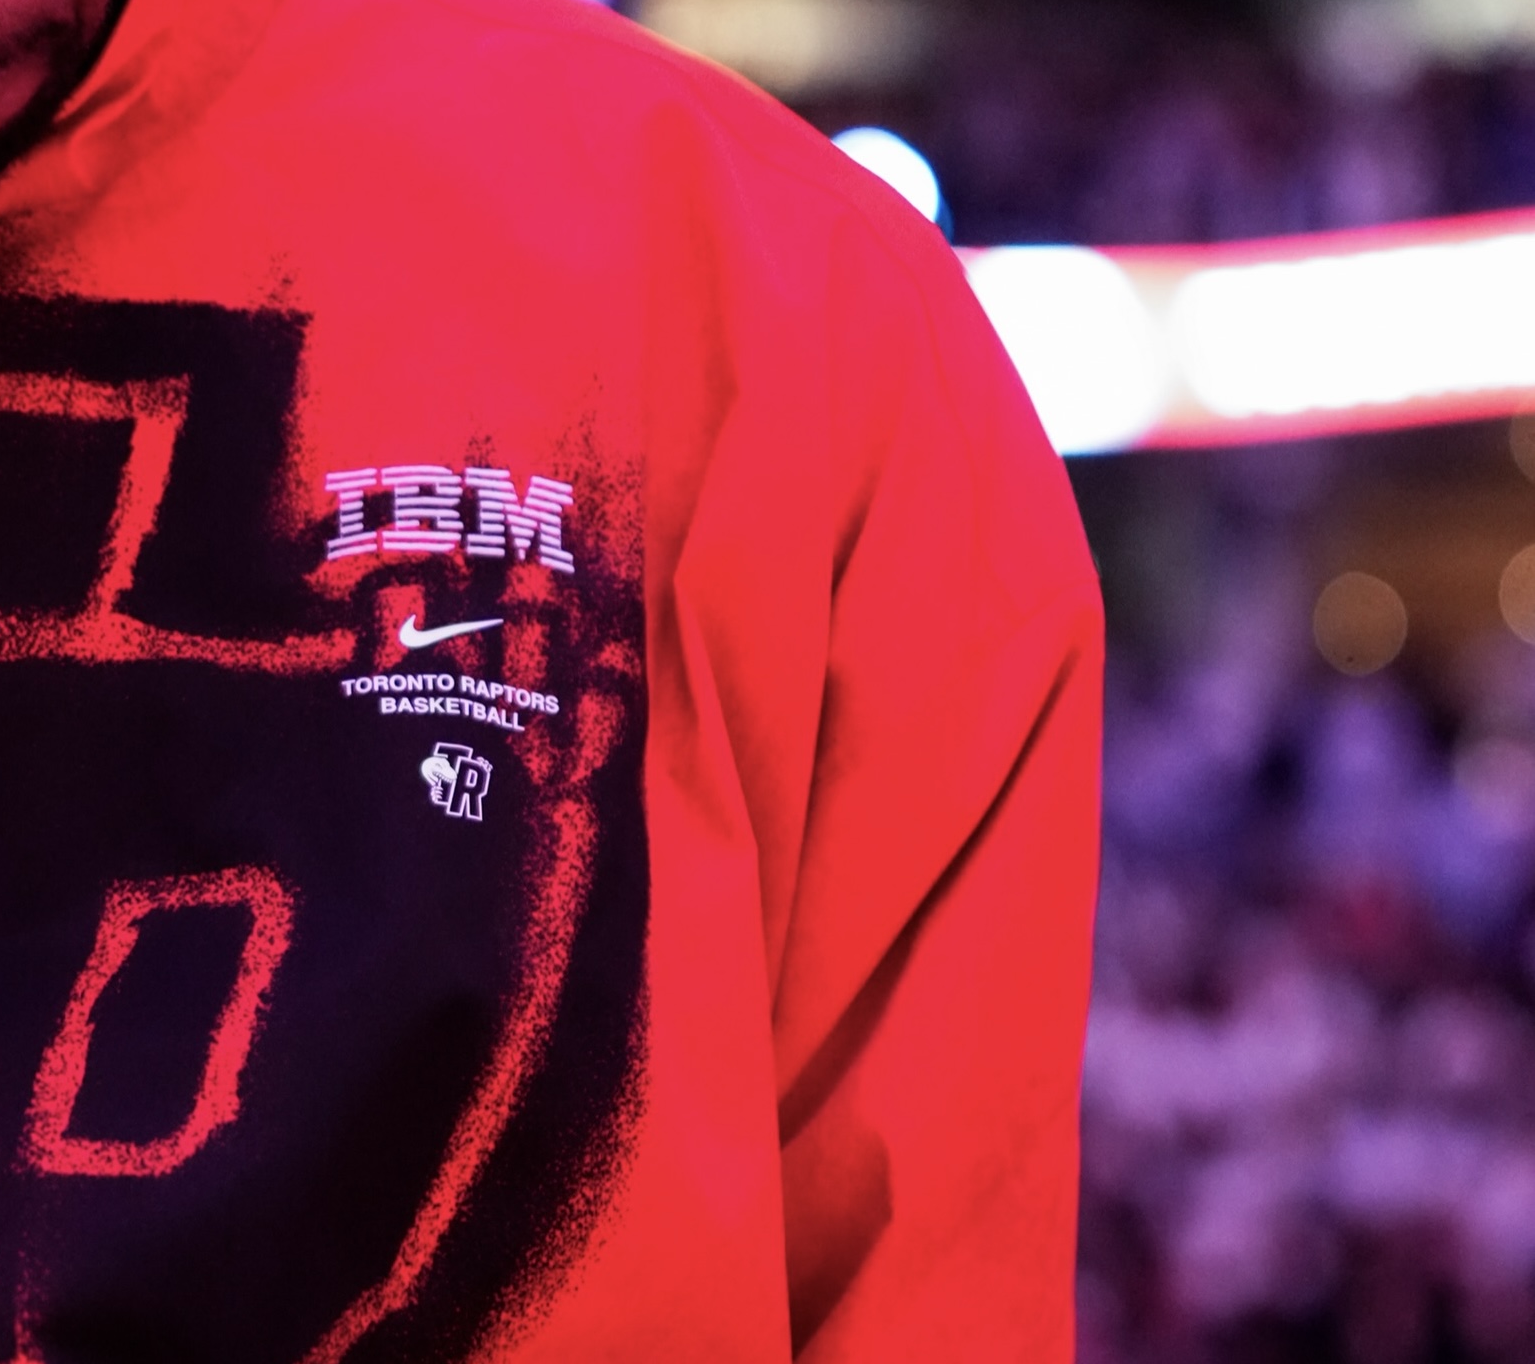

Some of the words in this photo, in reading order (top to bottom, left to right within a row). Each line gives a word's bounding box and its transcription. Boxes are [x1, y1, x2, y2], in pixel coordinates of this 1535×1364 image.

[324, 464, 575, 574] IBM
[341, 673, 455, 697] TORONTO
[460, 675, 560, 714] RAPTORS
[380, 696, 526, 732] BASKETBALL
